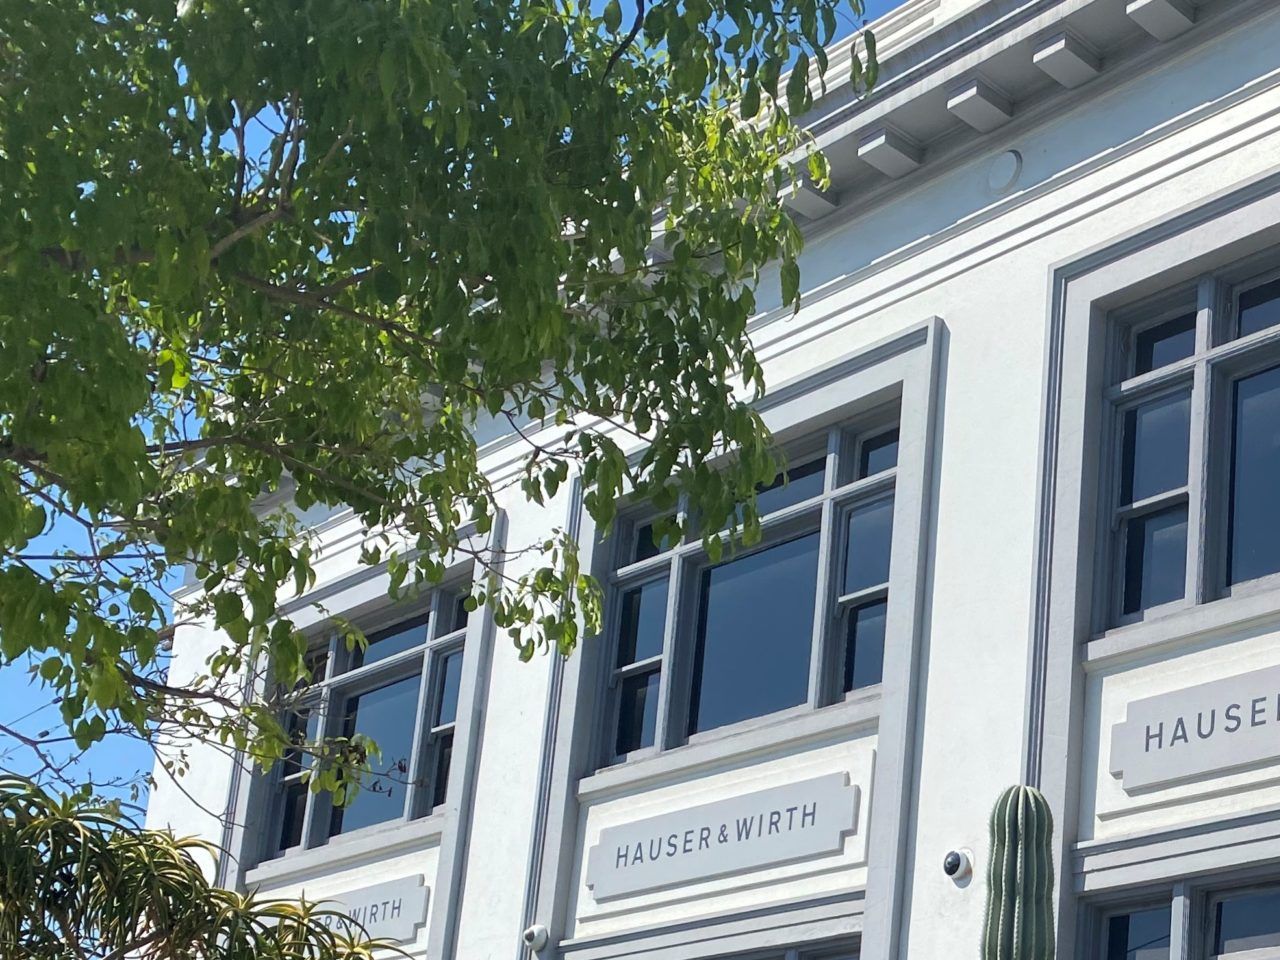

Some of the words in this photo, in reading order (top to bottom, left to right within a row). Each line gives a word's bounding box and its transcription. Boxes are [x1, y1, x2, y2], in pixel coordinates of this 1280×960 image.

[614, 826, 711, 870] HAUSER
[717, 823, 729, 844] &
[736, 801, 818, 842] WIRTH
[348, 897, 402, 929] WIRTH
